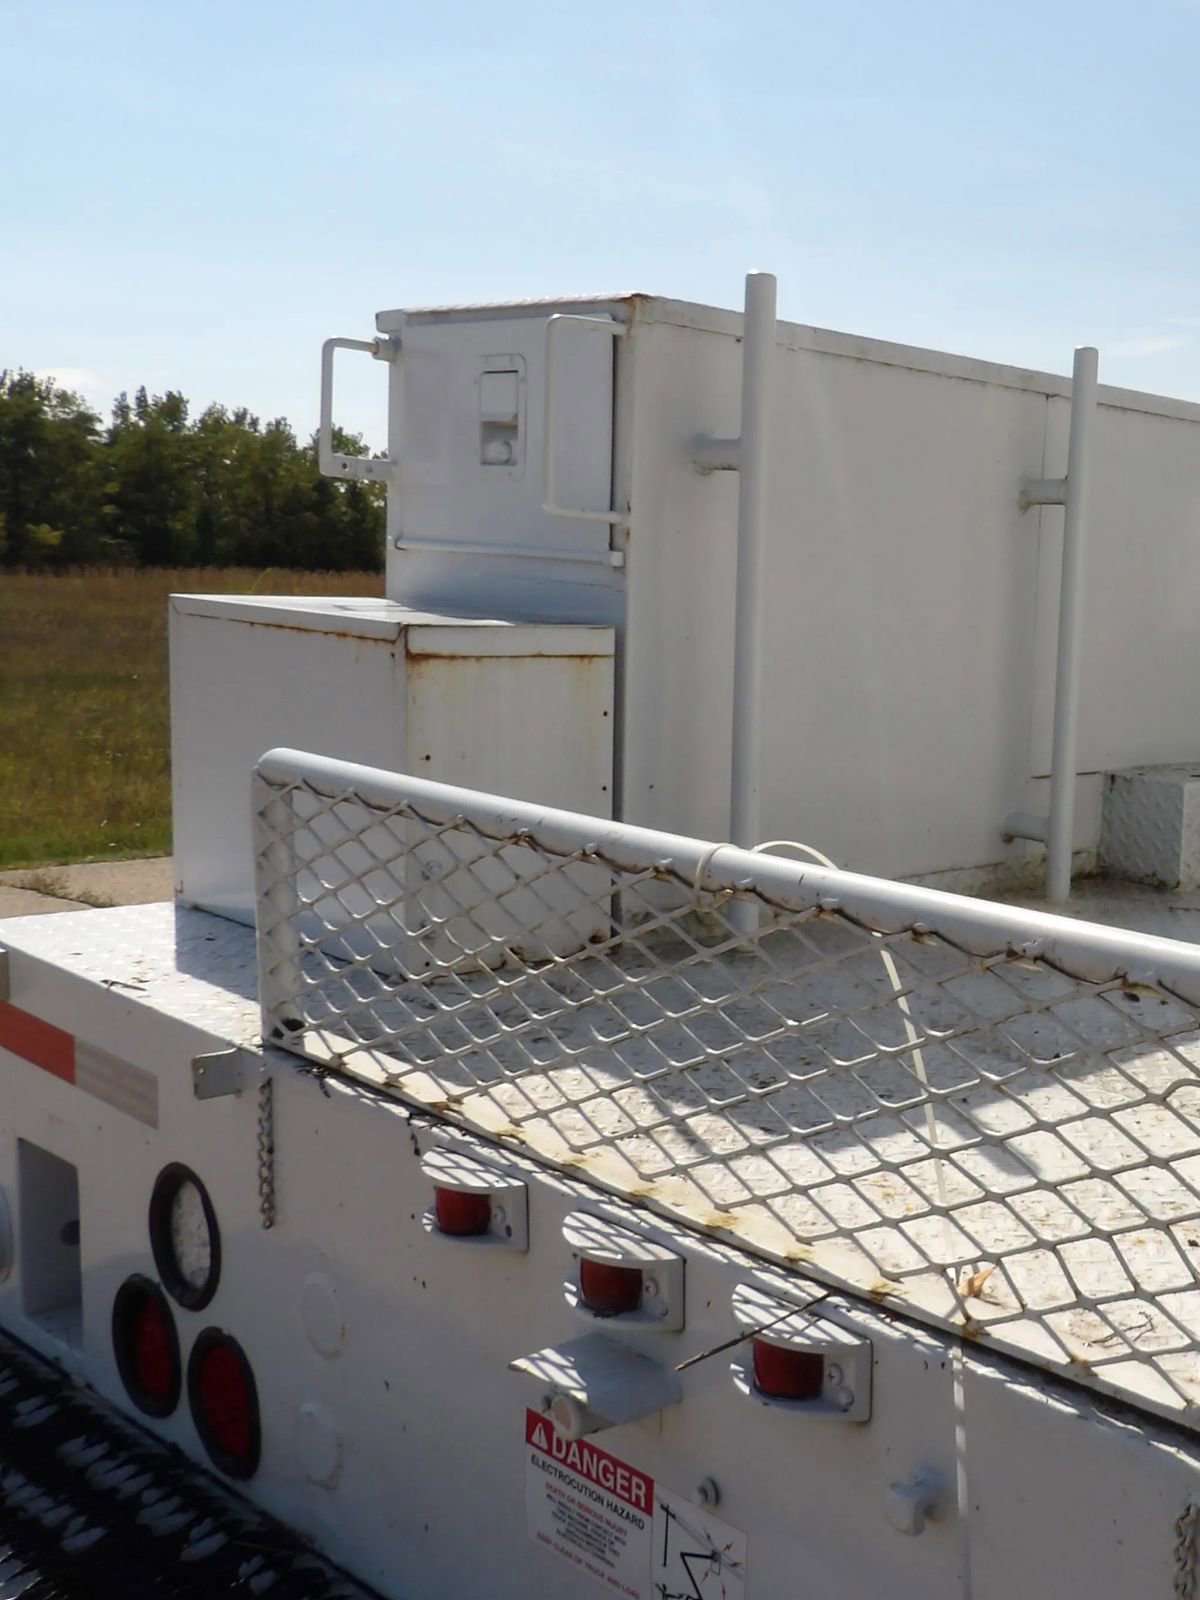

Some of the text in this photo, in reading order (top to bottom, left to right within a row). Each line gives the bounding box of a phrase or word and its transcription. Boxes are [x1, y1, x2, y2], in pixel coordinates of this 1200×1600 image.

[531, 1453, 605, 1506] ELECTROCUTION
[606, 1500, 645, 1531] HAZARD
[552, 1436, 647, 1509] DANGER
